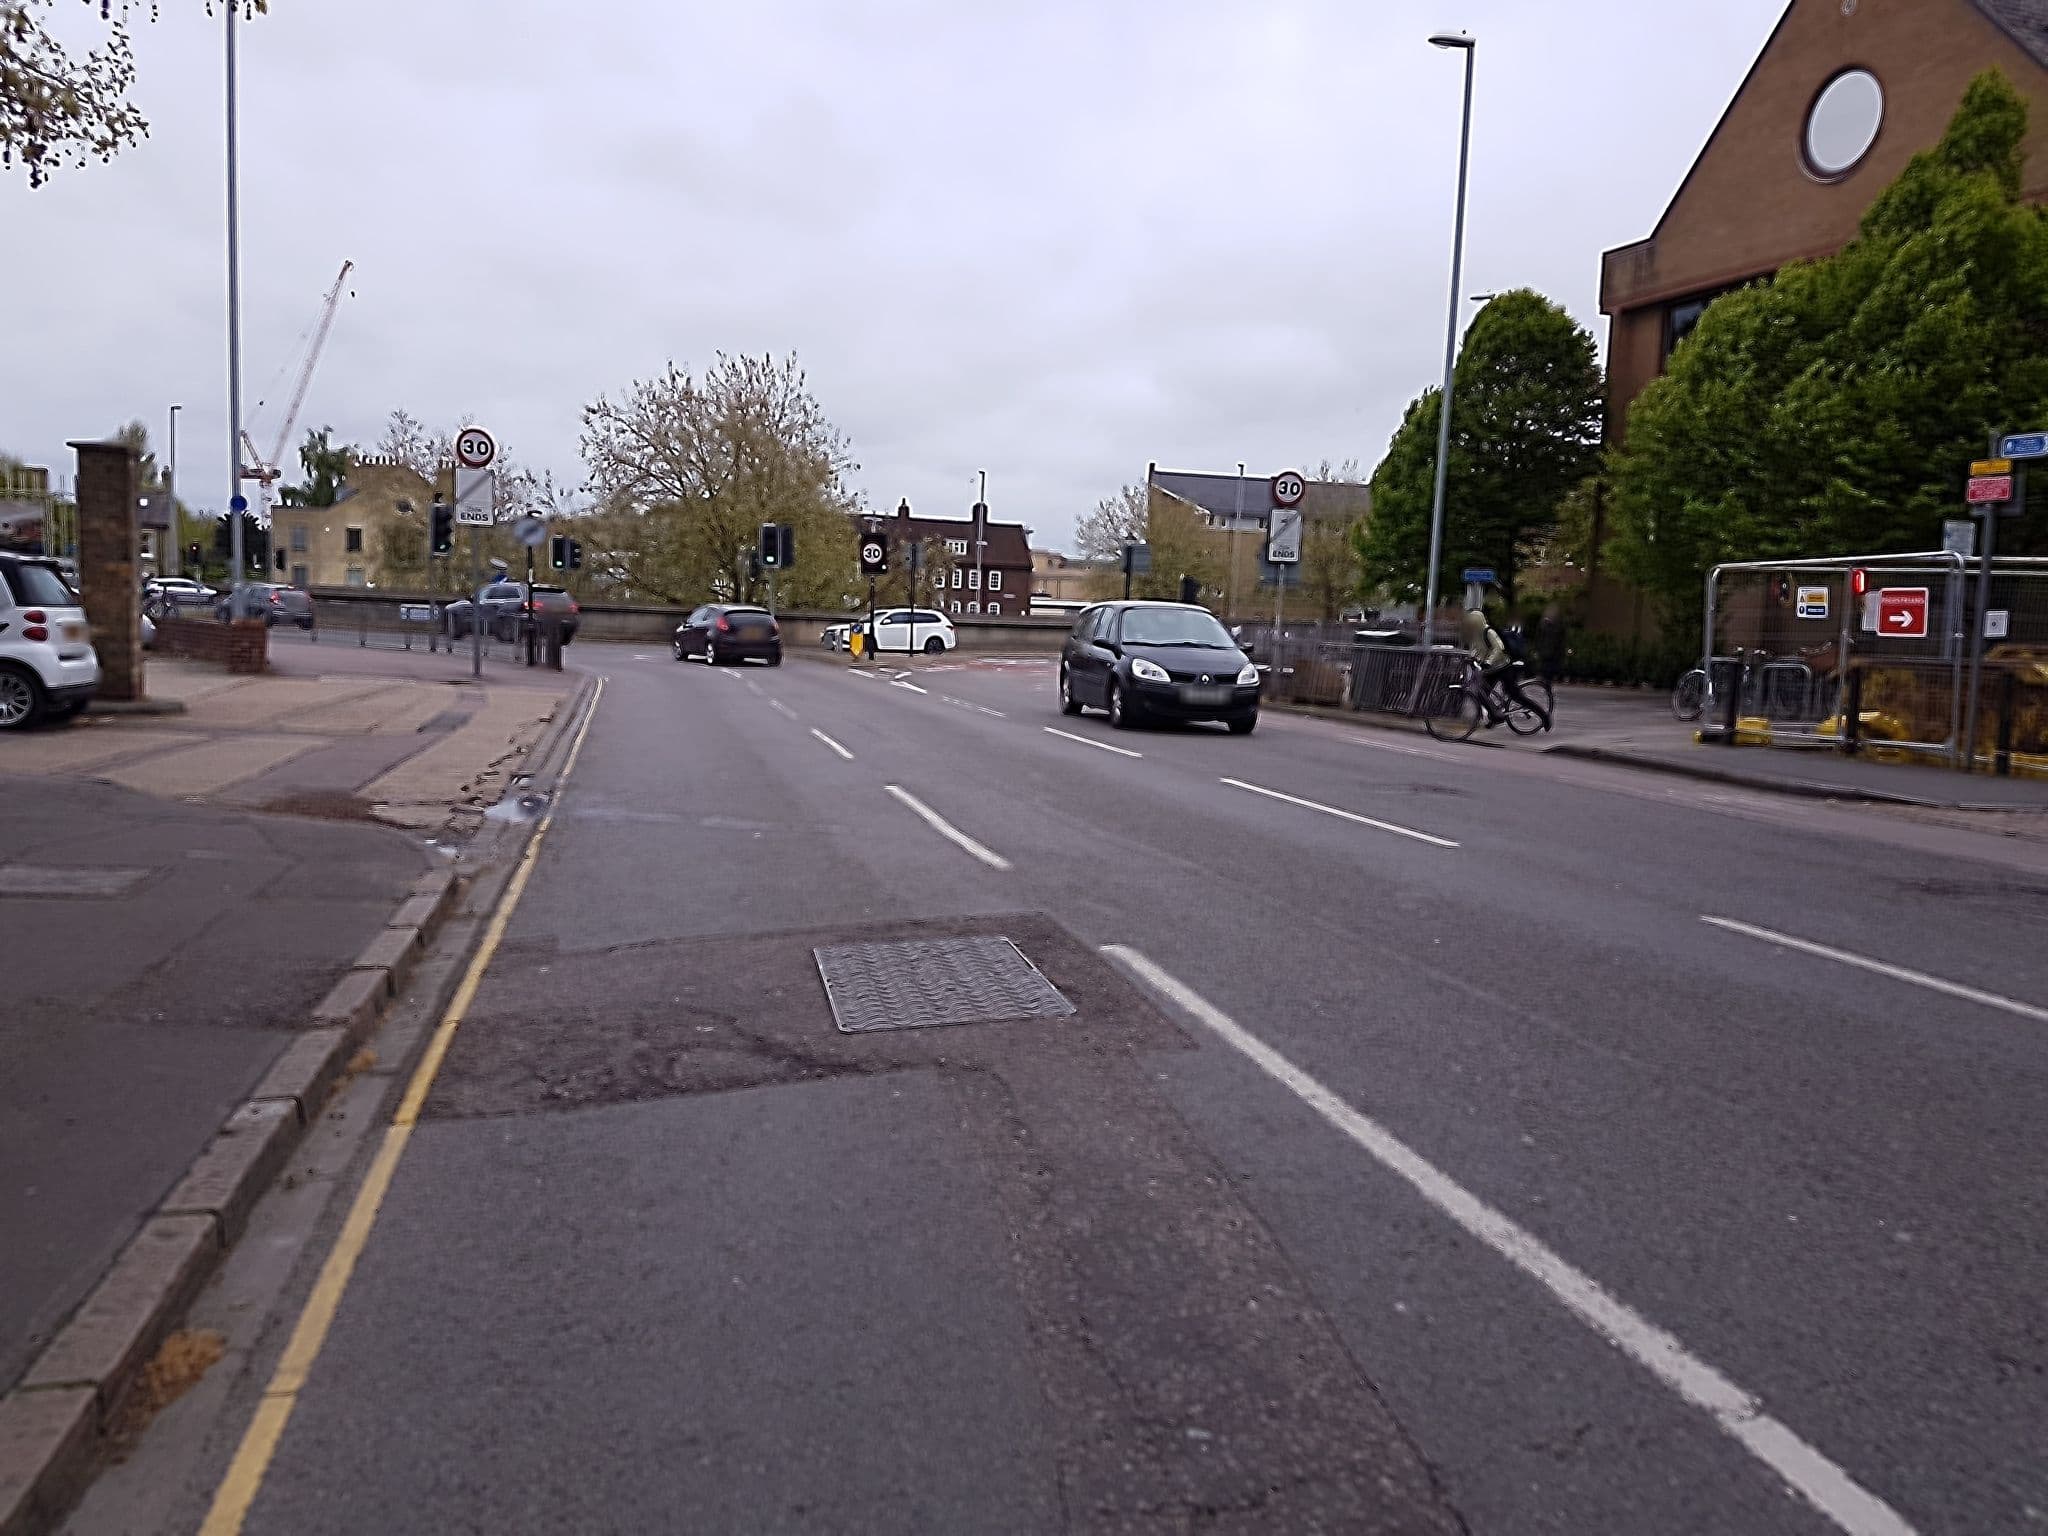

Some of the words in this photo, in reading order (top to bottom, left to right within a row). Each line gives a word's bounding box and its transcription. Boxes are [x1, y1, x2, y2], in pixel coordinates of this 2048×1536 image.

[463, 439, 489, 456] 30
[1279, 481, 1300, 496] 30
[460, 512, 488, 521] ENDS
[864, 548, 880, 558] 30
